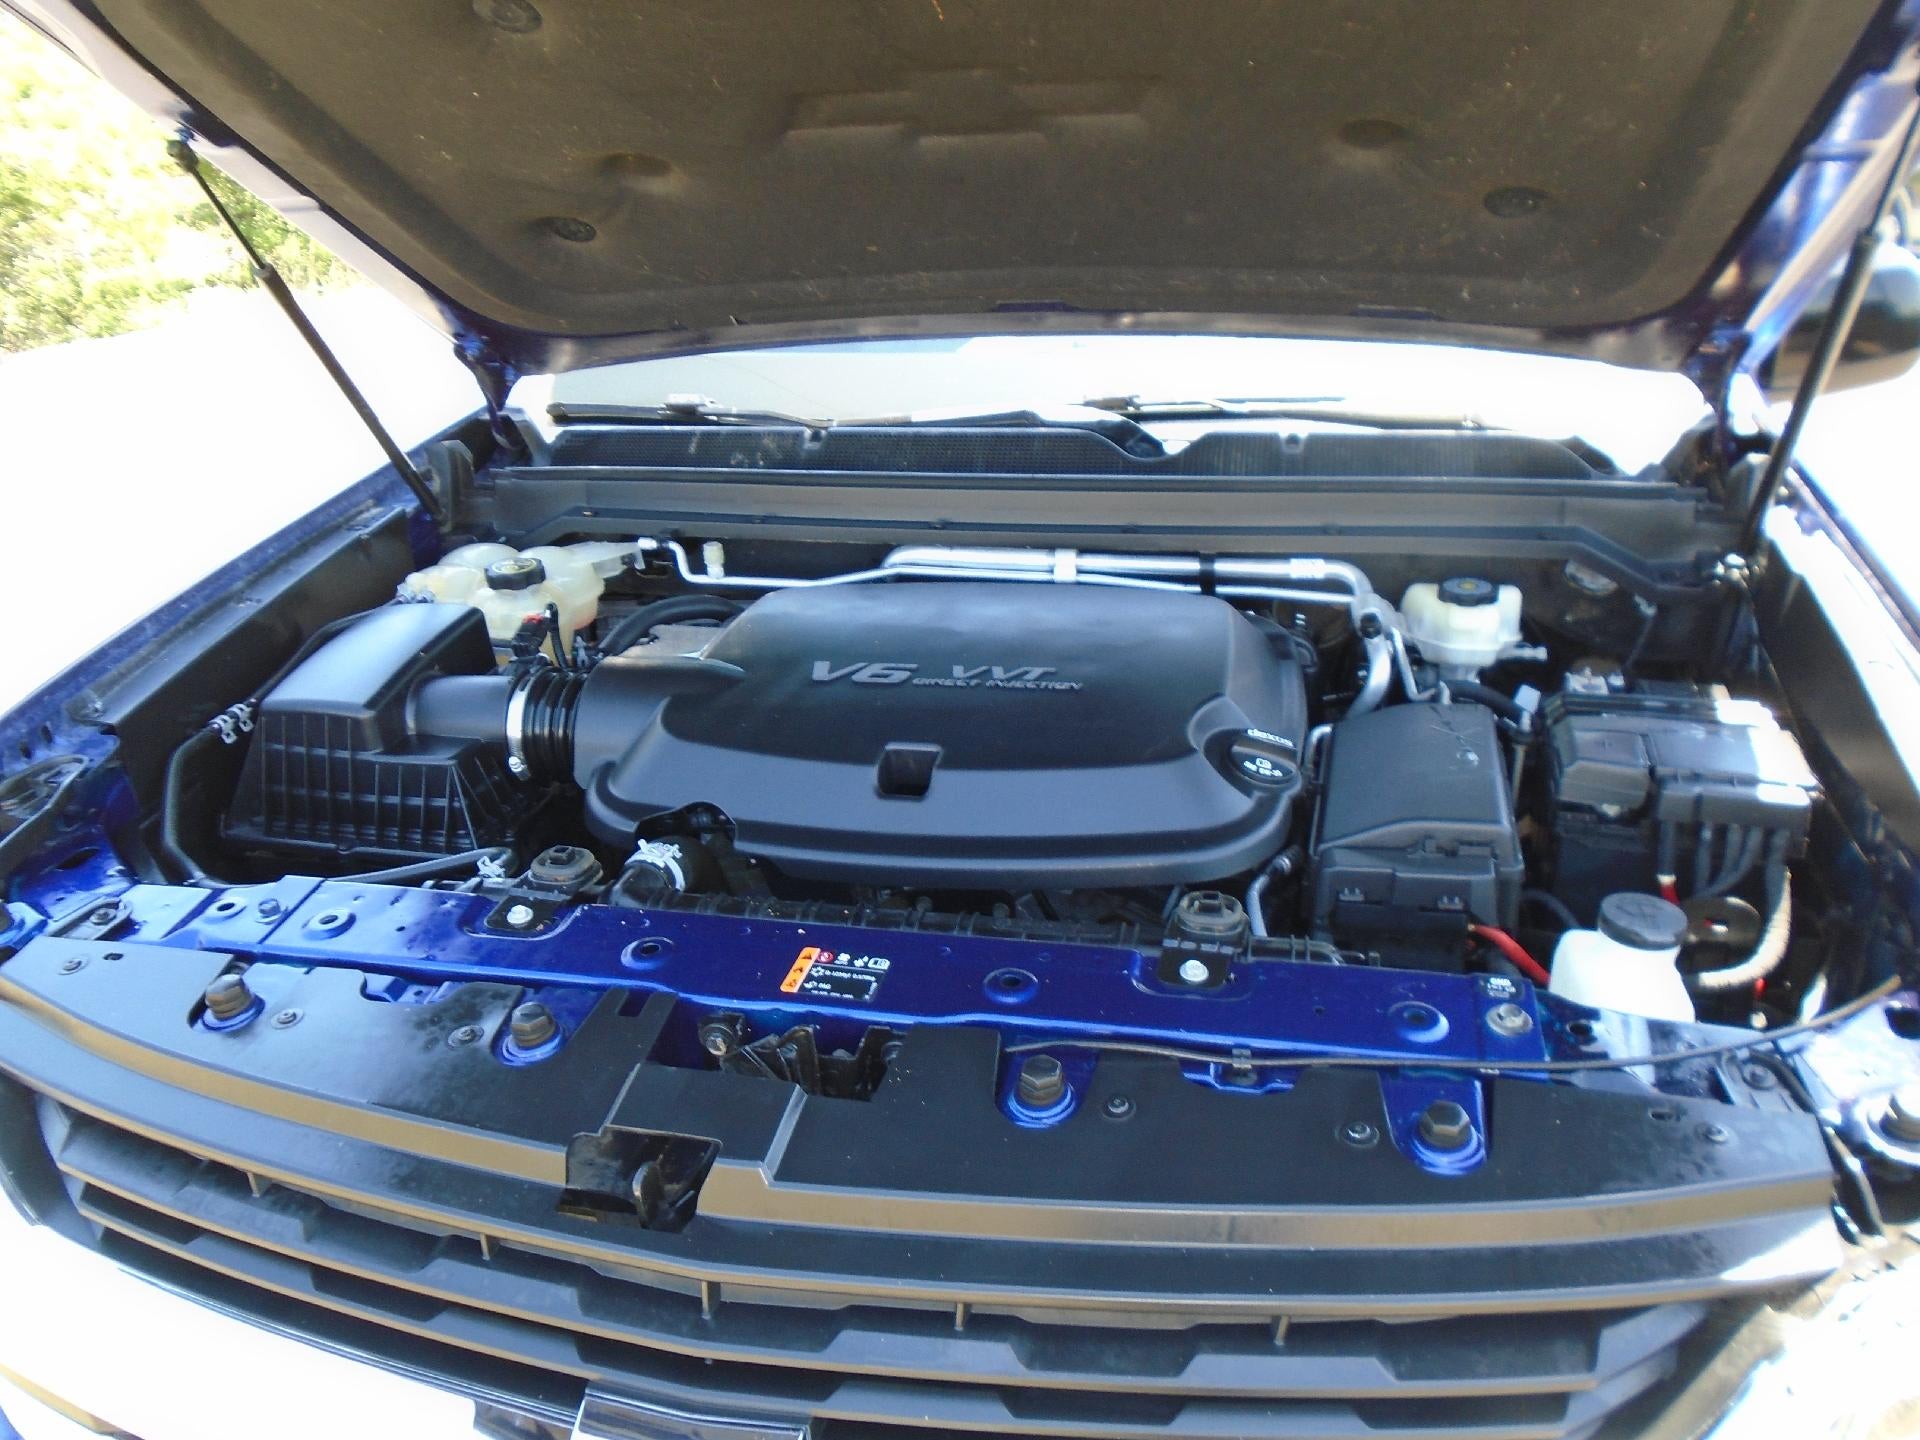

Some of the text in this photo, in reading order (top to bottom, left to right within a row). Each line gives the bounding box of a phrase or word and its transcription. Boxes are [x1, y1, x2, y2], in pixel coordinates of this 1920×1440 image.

[812, 660, 1057, 684] V6 VVT
[912, 677, 1083, 690] DIRECT INJECTION
